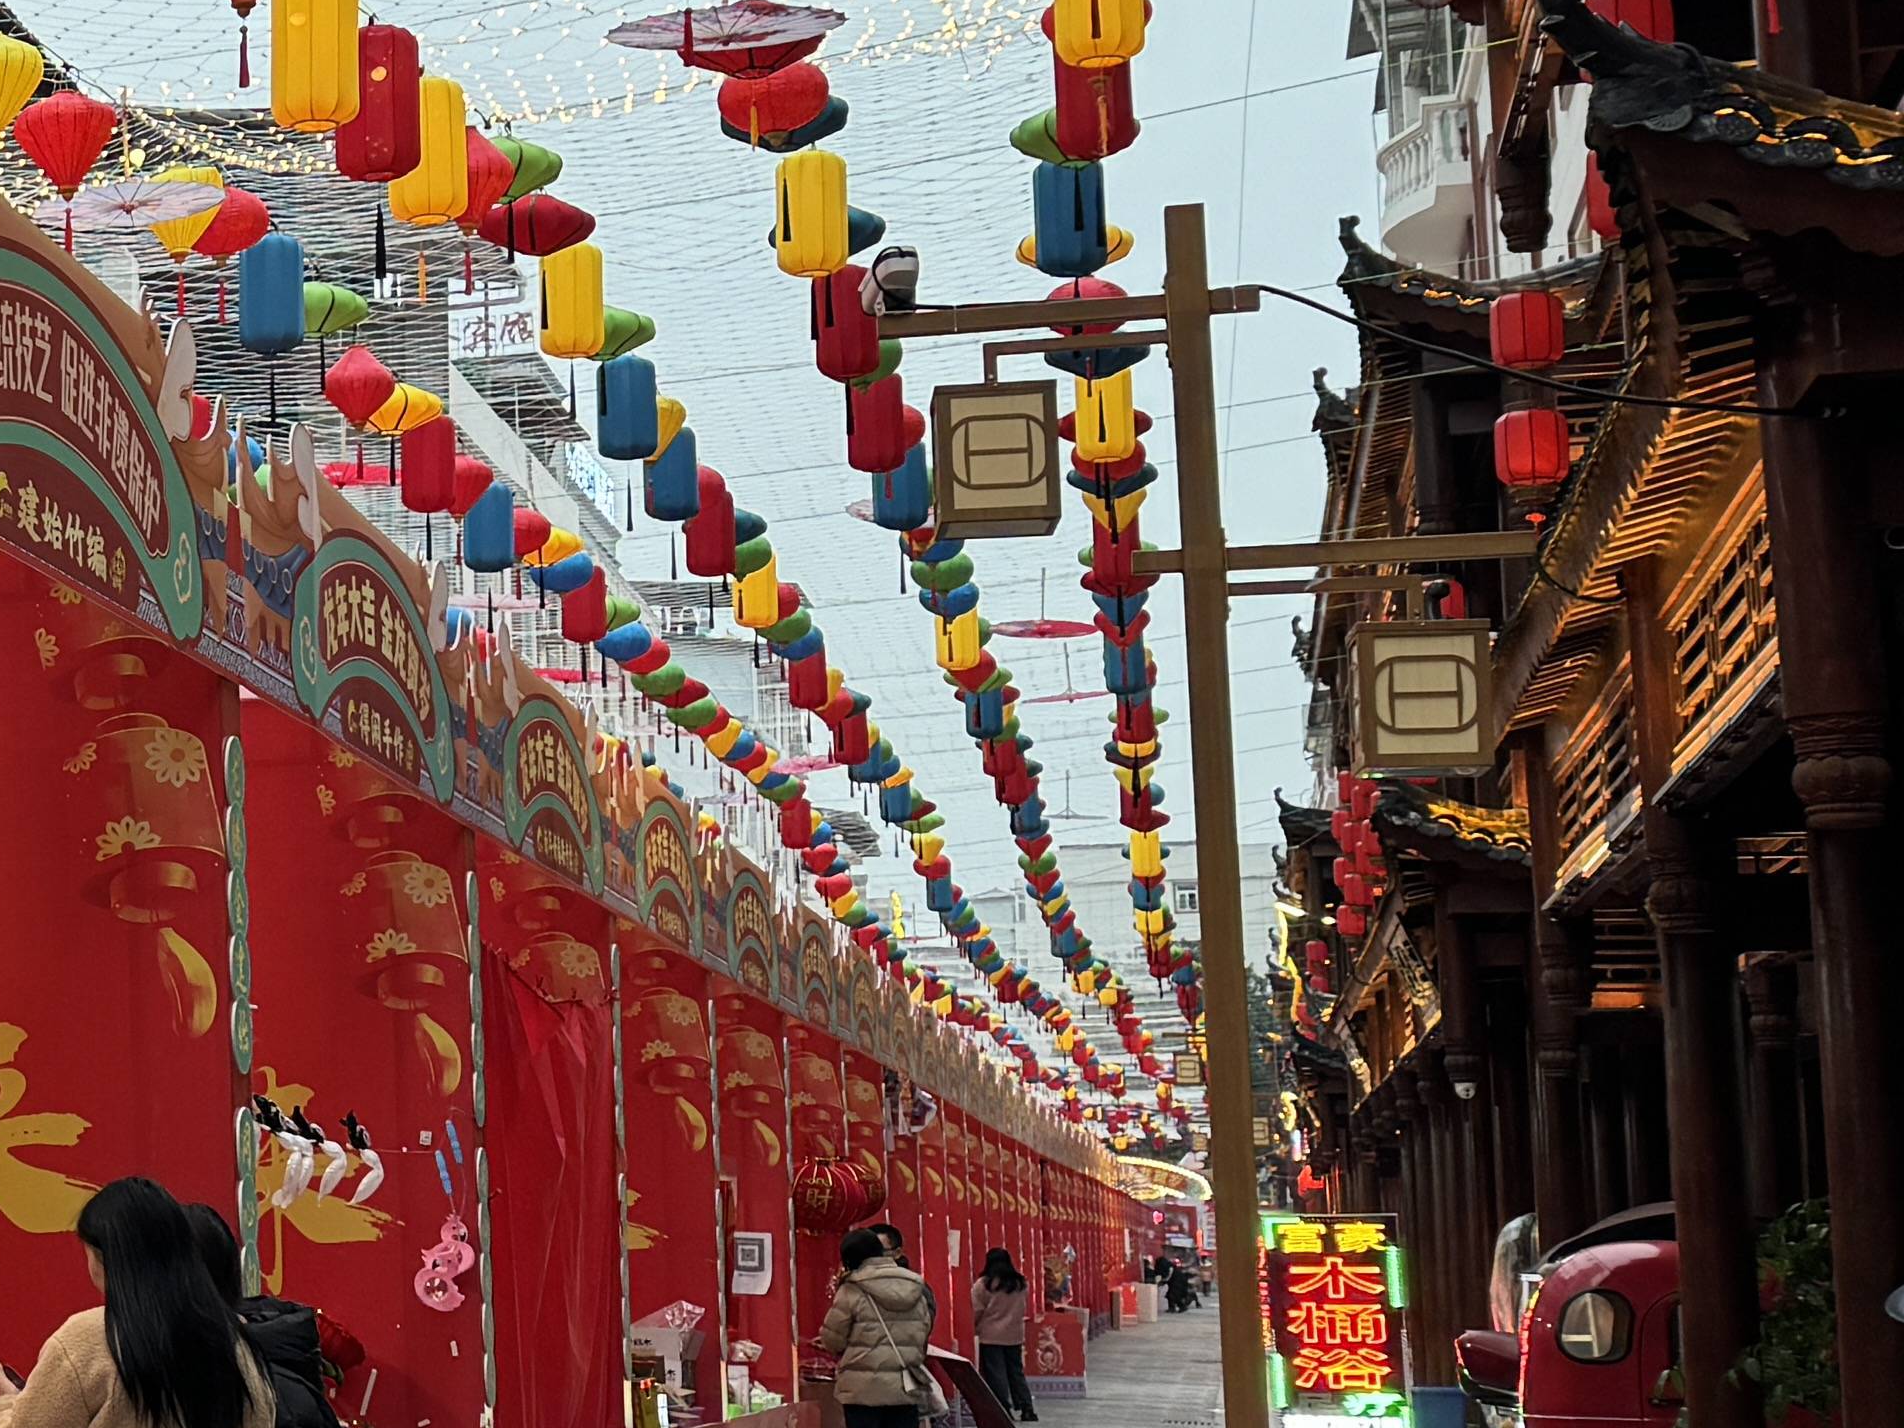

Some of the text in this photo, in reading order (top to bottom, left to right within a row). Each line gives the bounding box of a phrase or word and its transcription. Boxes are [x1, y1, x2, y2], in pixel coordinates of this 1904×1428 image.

[59, 334, 162, 541] 促进非遗保护
[17, 479, 109, 584] 建始竹编
[323, 575, 376, 661] 龙年大吉
[1277, 1220, 1386, 1254] 富豪
[1286, 1255, 1393, 1390] 木桶浴
